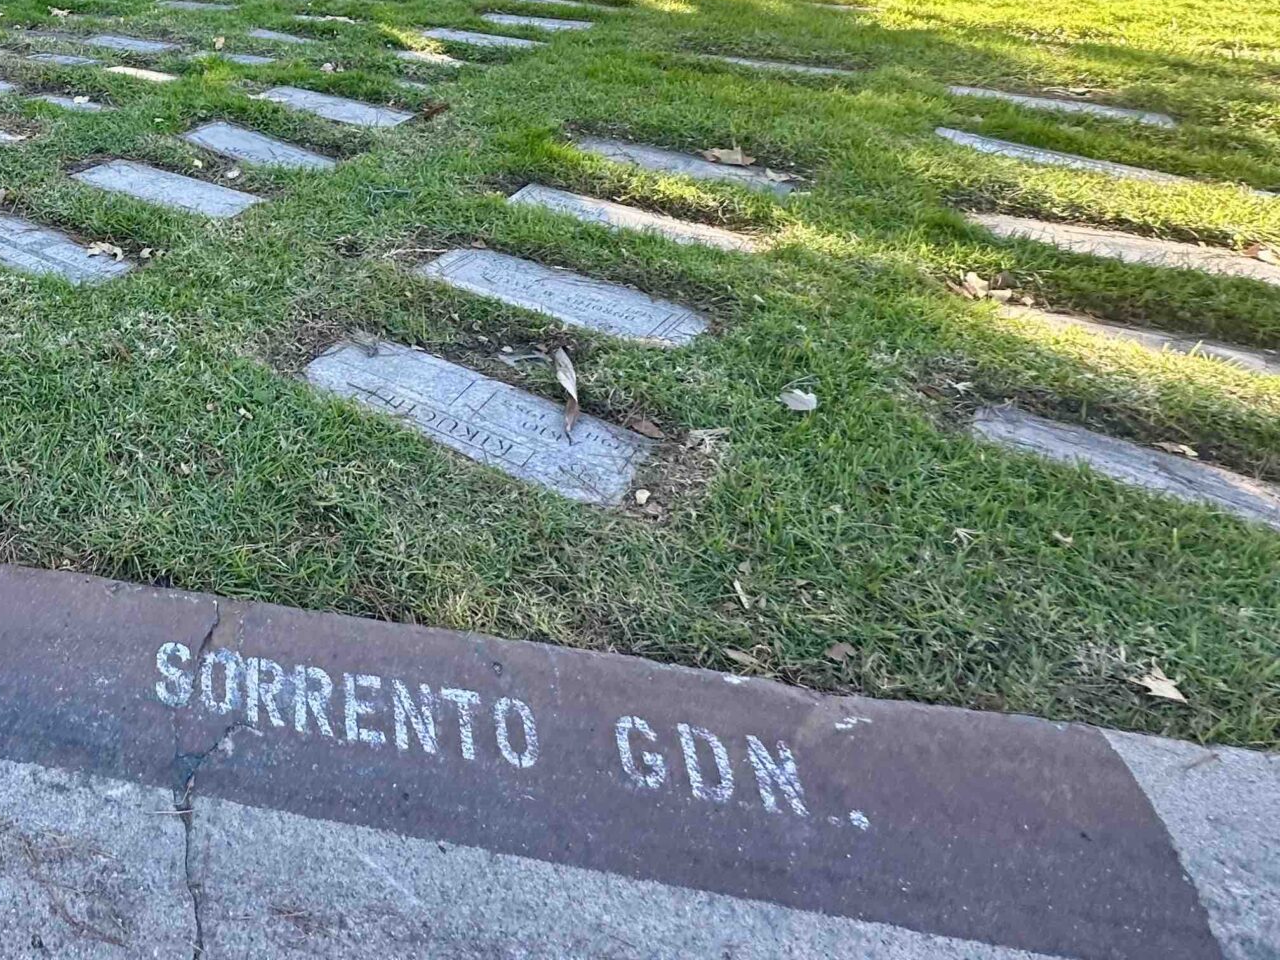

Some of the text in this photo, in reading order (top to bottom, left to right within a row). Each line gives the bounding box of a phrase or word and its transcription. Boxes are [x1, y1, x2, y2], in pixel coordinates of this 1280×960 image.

[383, 394, 514, 456] KIKUCHI
[155, 642, 871, 831] SORRENTO GDN.
